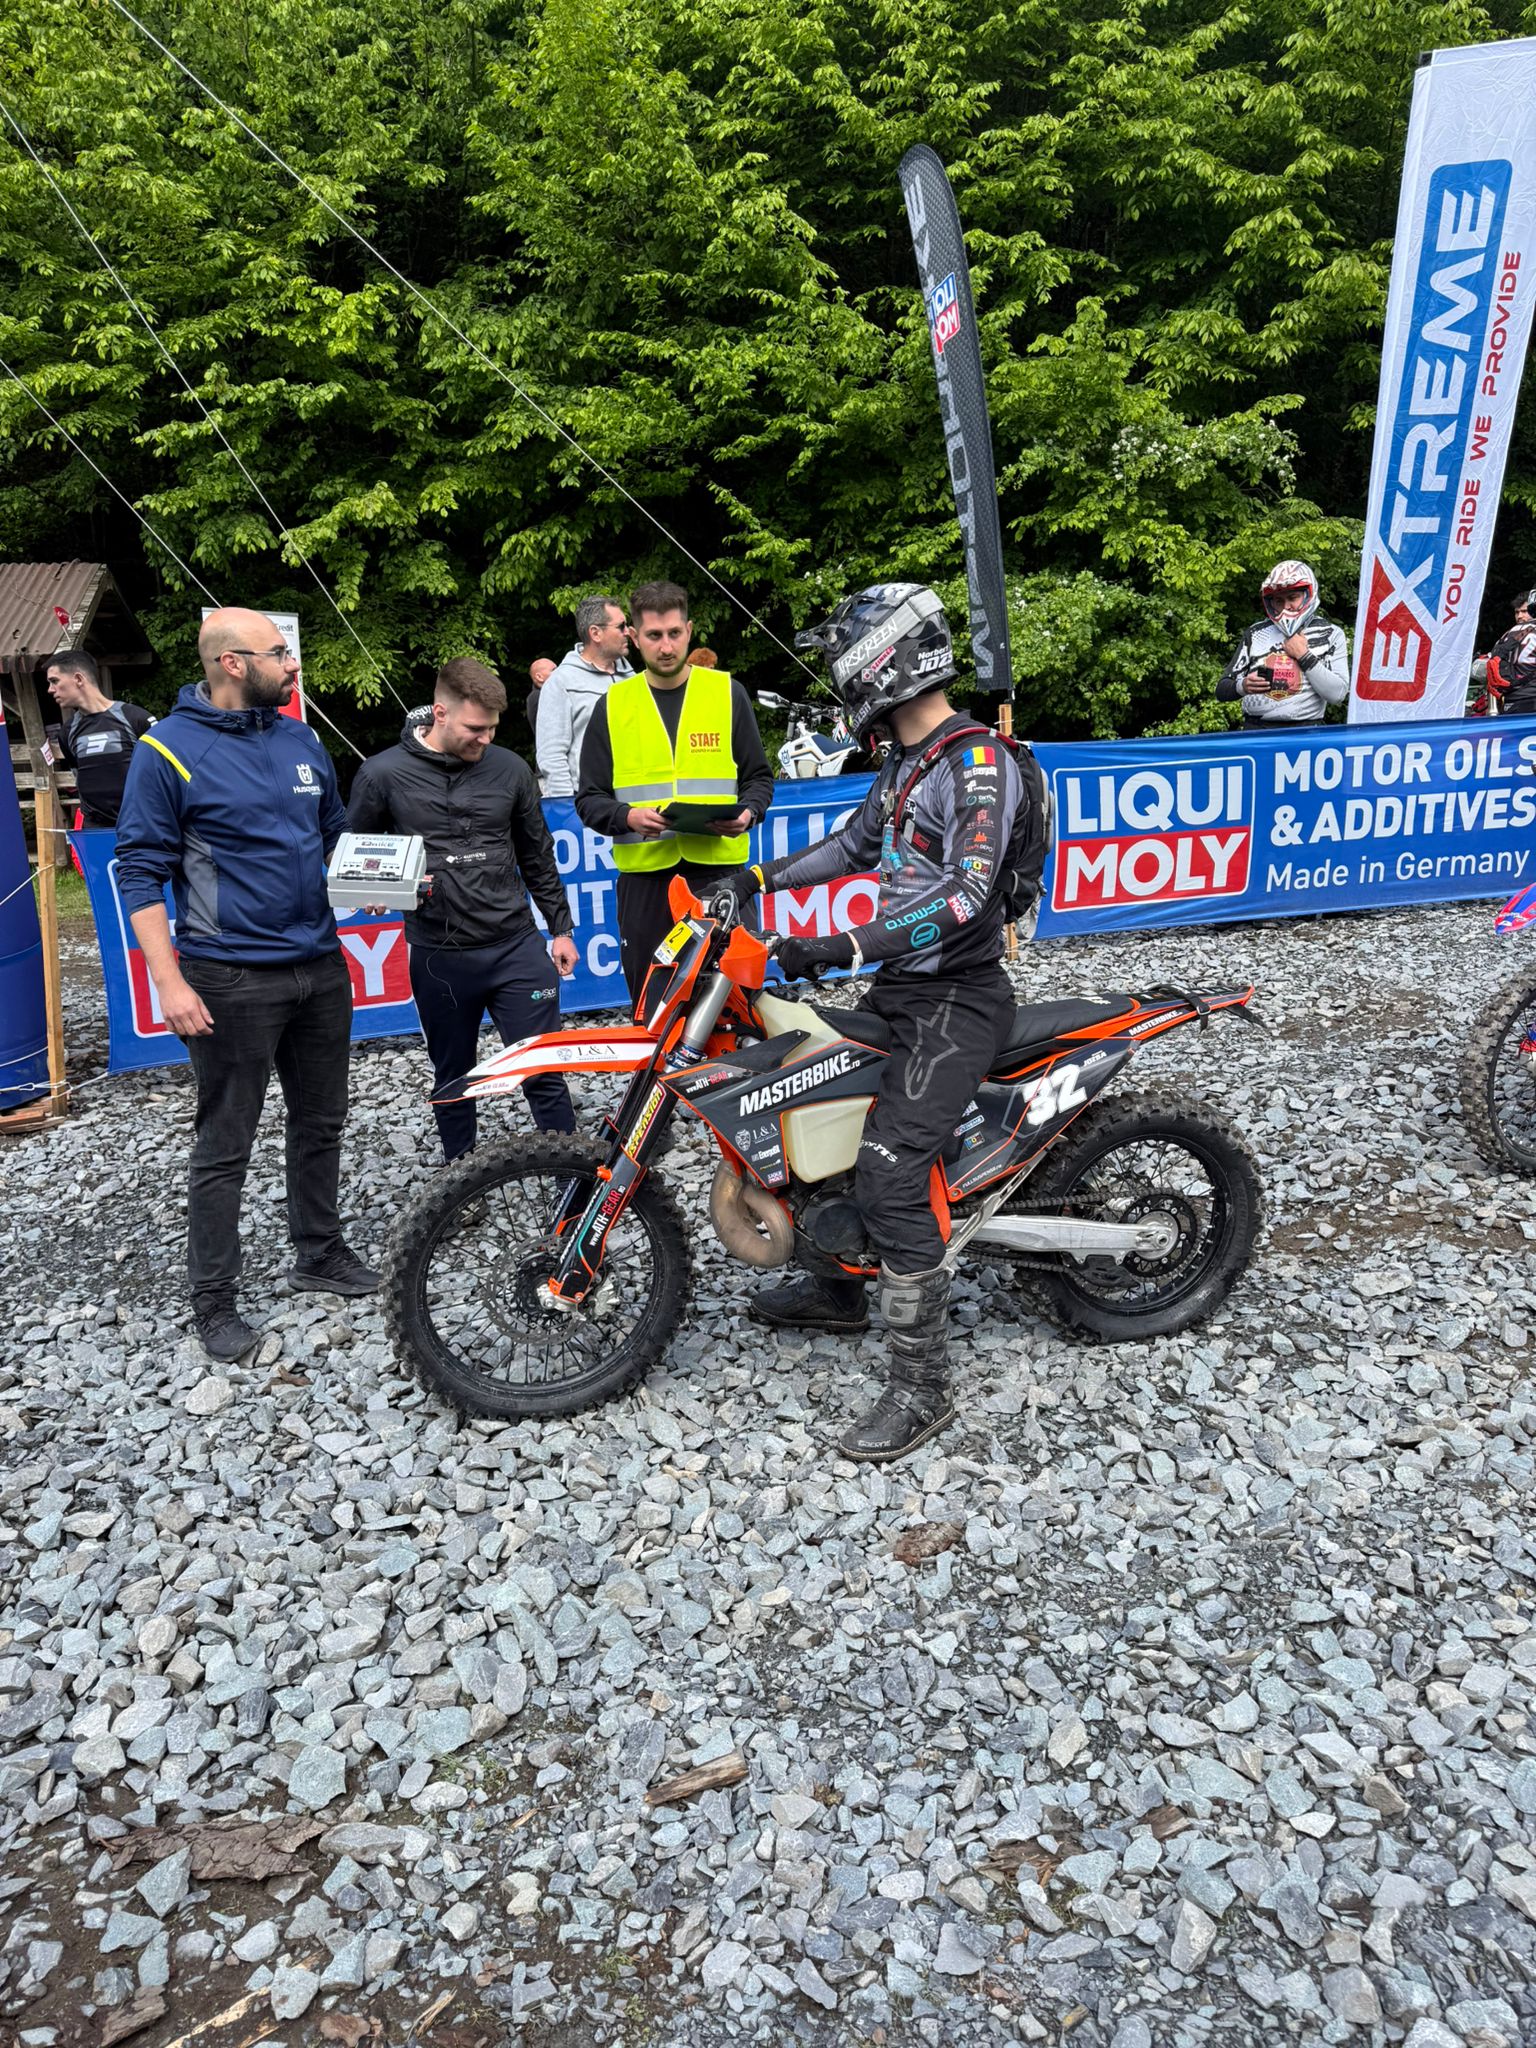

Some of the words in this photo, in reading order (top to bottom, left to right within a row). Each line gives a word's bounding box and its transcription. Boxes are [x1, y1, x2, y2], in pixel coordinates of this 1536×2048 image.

[1369, 184, 1497, 683] EXTREME
[1442, 564, 1466, 625] YOU
[1456, 478, 1481, 546] RIDE
[1469, 414, 1494, 461] WE
[1482, 251, 1522, 397] PROVIDE
[278, 623, 294, 632] redit
[911, 650, 953, 675] JOZS
[917, 645, 949, 660] Norbert
[690, 732, 720, 748] STAFF
[1274, 741, 1433, 795] MOTOR
[1445, 735, 1536, 780] OILS
[1066, 765, 1243, 833] LIQUI
[1270, 804, 1304, 847] &
[1308, 786, 1536, 844] ADDITIVES
[1064, 832, 1248, 903] MOLY
[1266, 858, 1350, 893] Made
[1359, 855, 1386, 884] in
[1396, 849, 1531, 881] Germany
[885, 897, 948, 931] CFMOTO
[950, 896, 968, 925] MOLY
[957, 890, 976, 920] LIQUI
[1021, 1063, 1088, 1126] 32
